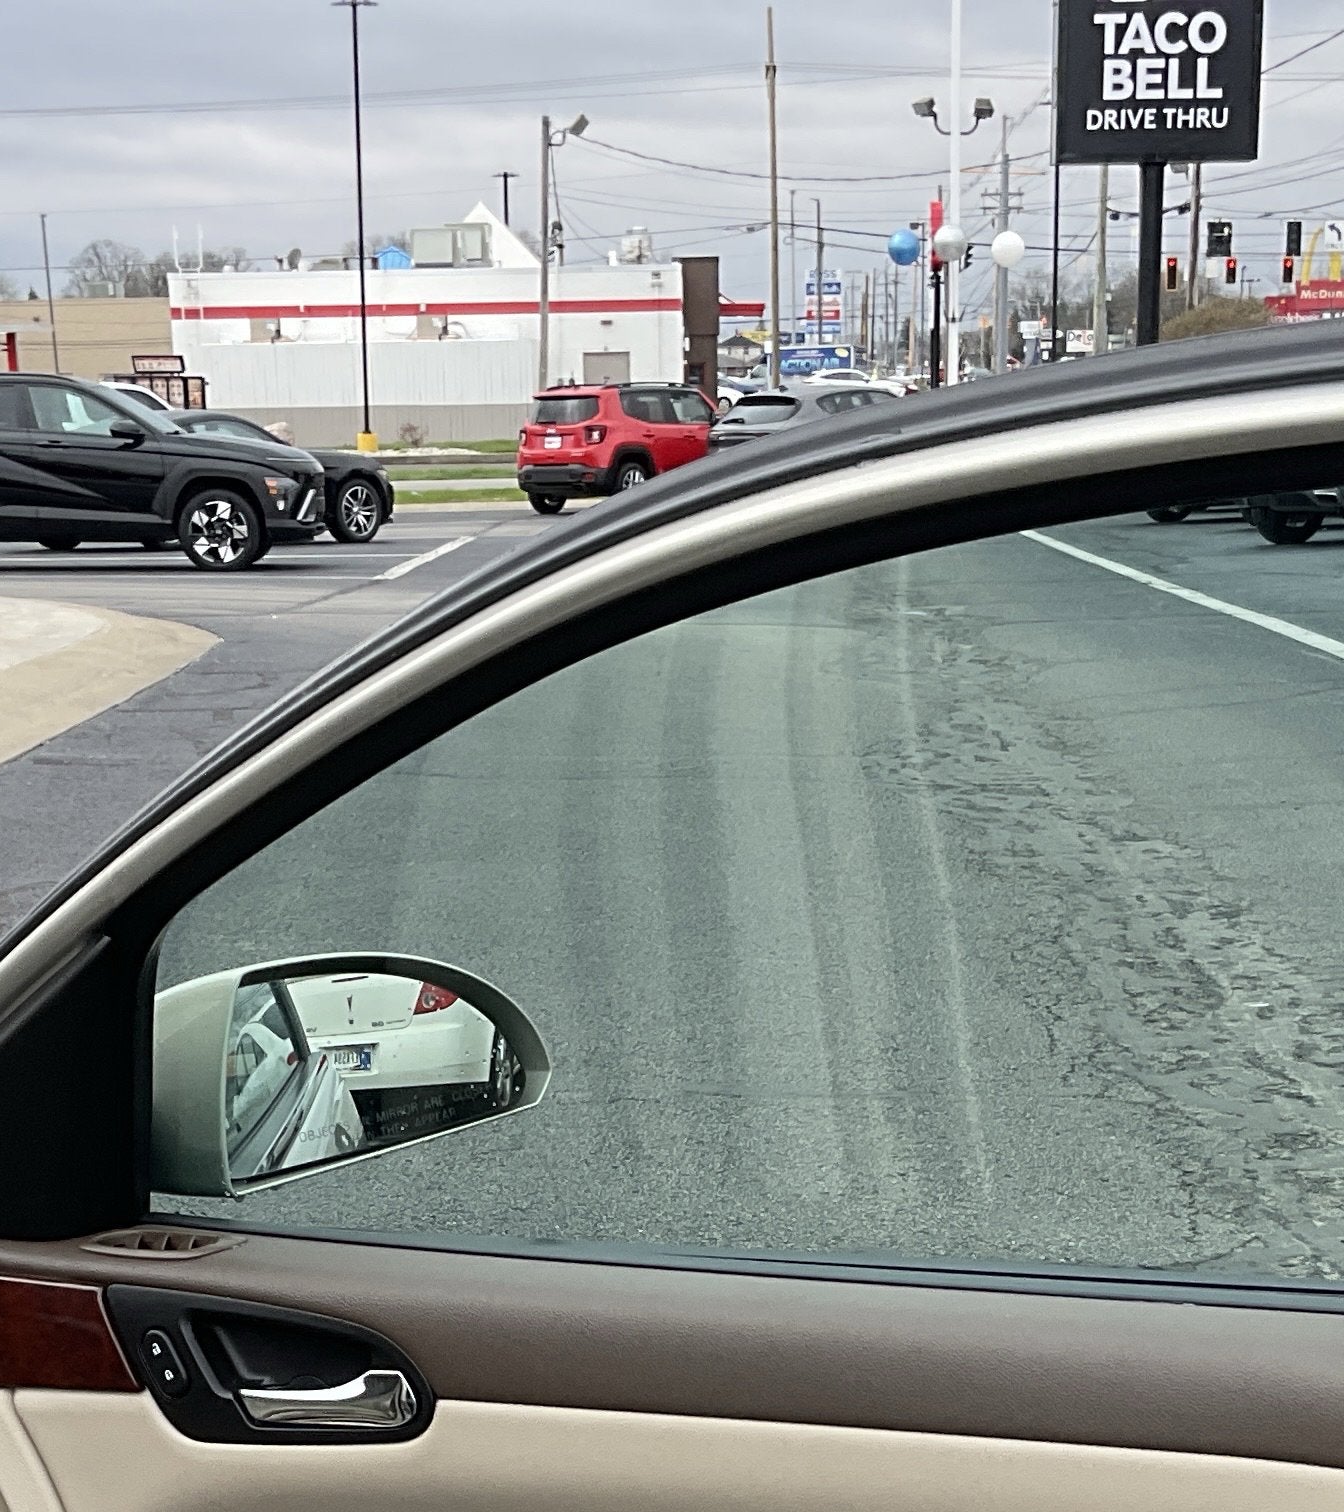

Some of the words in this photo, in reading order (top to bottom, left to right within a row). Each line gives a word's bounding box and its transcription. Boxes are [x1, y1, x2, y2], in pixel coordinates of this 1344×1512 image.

[1093, 10, 1227, 55] TACO
[1102, 56, 1223, 101] BELL
[1085, 107, 1157, 131] DRIVE
[1162, 106, 1229, 129] THRU
